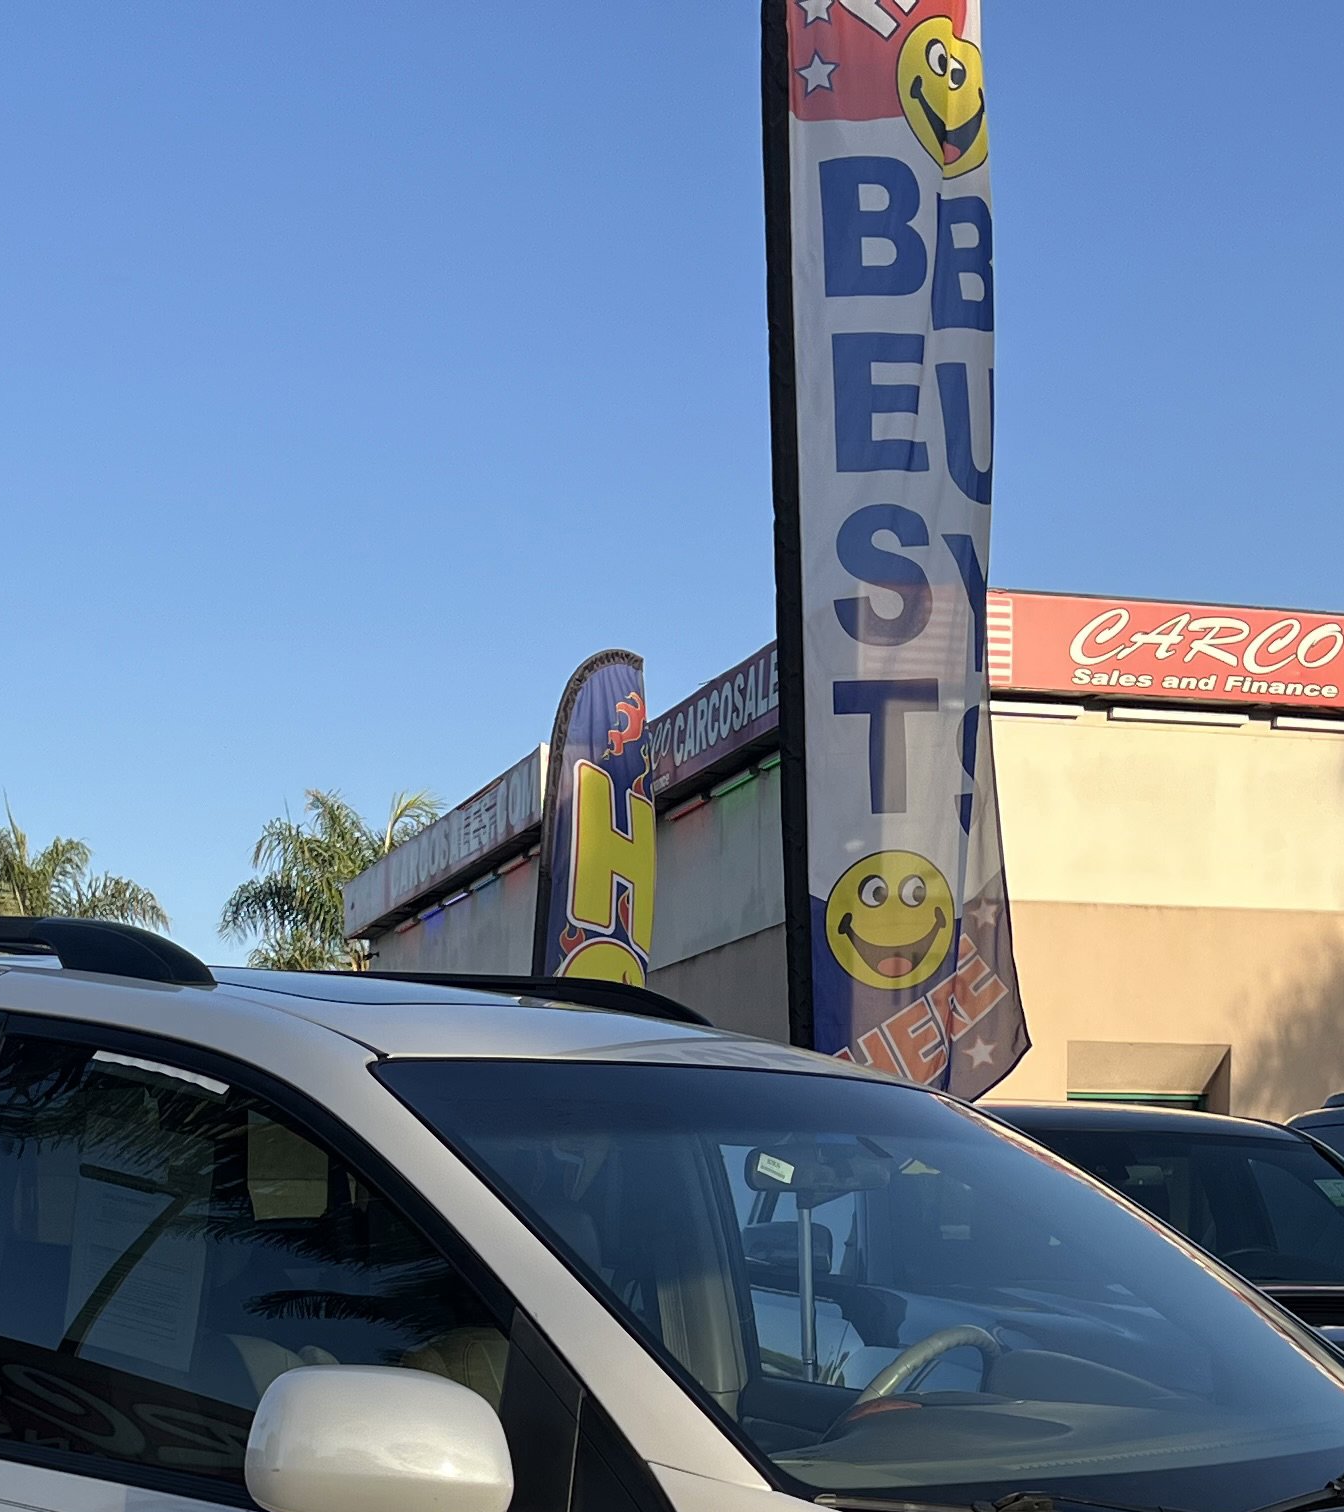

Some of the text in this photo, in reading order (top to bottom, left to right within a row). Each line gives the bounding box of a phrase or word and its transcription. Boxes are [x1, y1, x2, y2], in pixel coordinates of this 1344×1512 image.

[818, 155, 939, 815] BEST
[1068, 607, 1344, 674] CARCO
[1070, 668, 1340, 699] Sales and Finance
